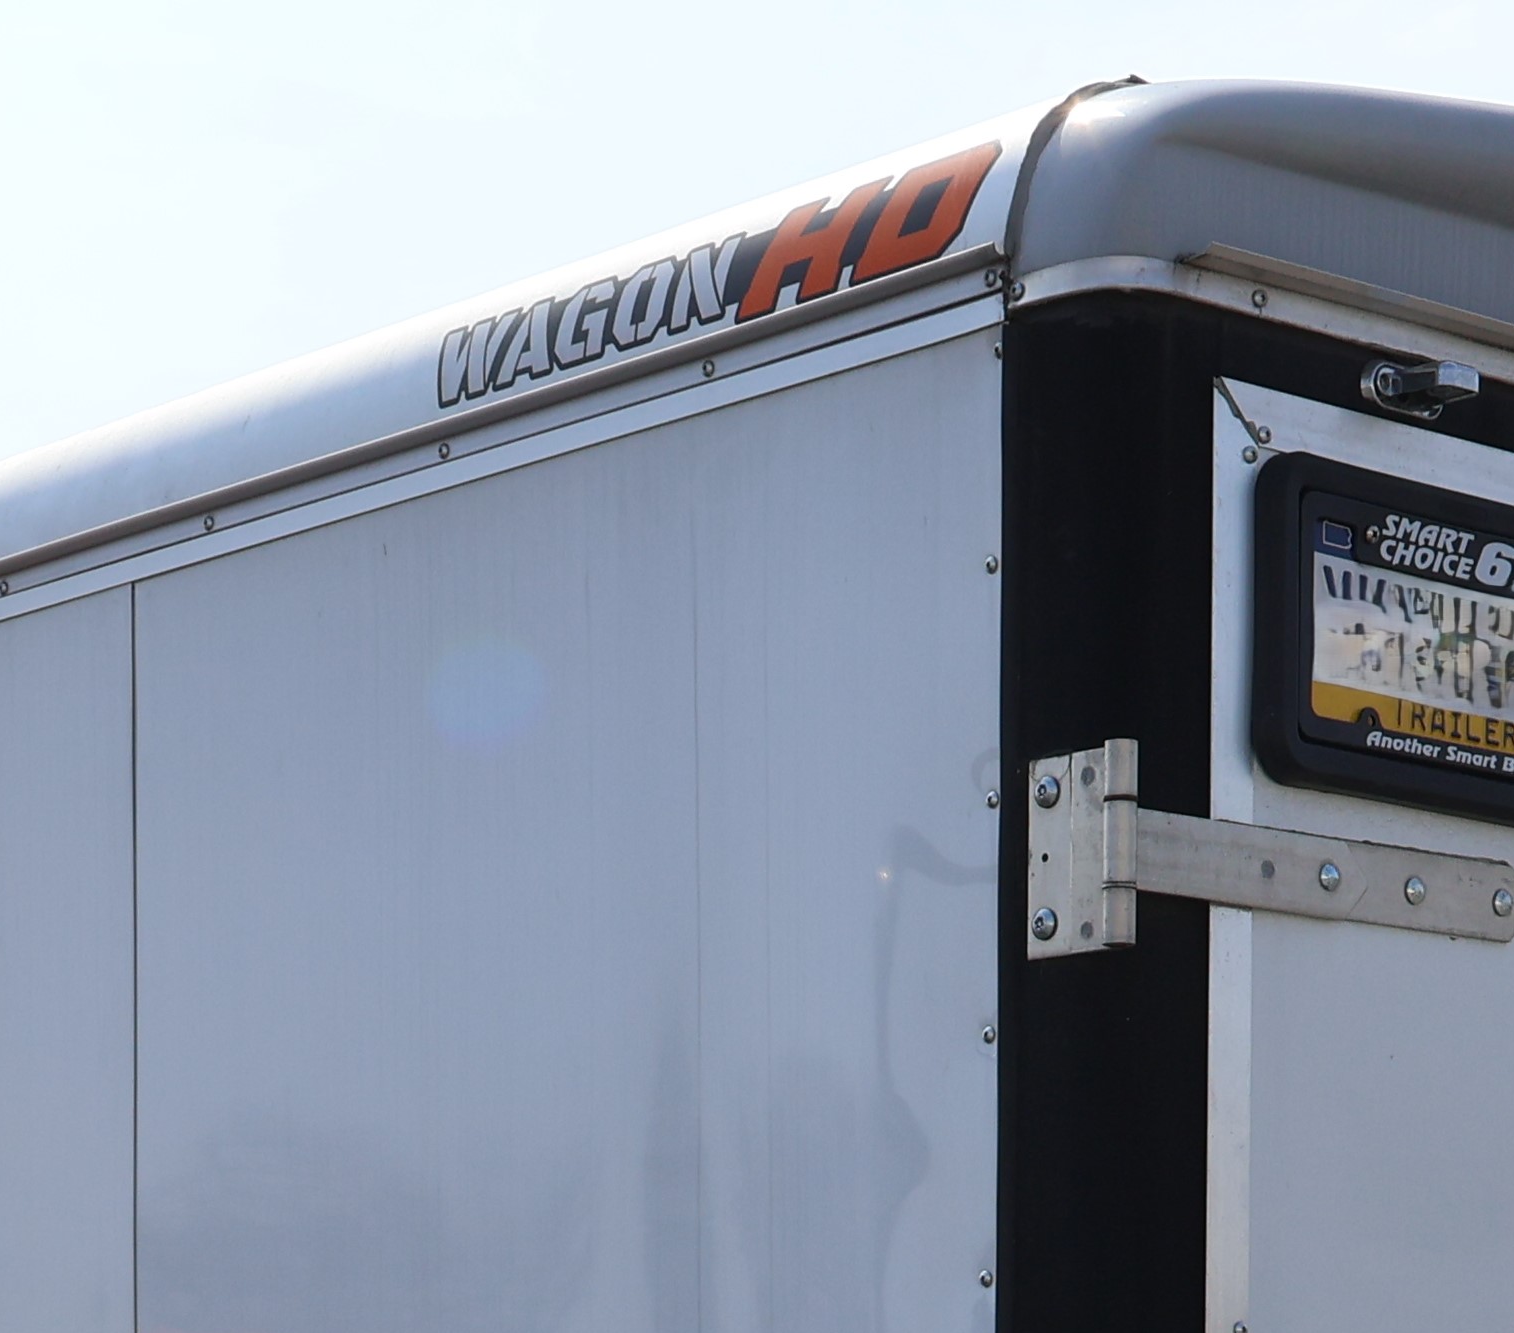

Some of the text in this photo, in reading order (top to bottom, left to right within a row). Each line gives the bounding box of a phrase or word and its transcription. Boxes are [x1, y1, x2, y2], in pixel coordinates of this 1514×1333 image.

[438, 140, 1002, 408] WAGON HD
[1382, 514, 1475, 554] SMART
[1380, 539, 1474, 580] CHOICE
[1366, 731, 1442, 757] Another
[1446, 746, 1497, 769] Smart
